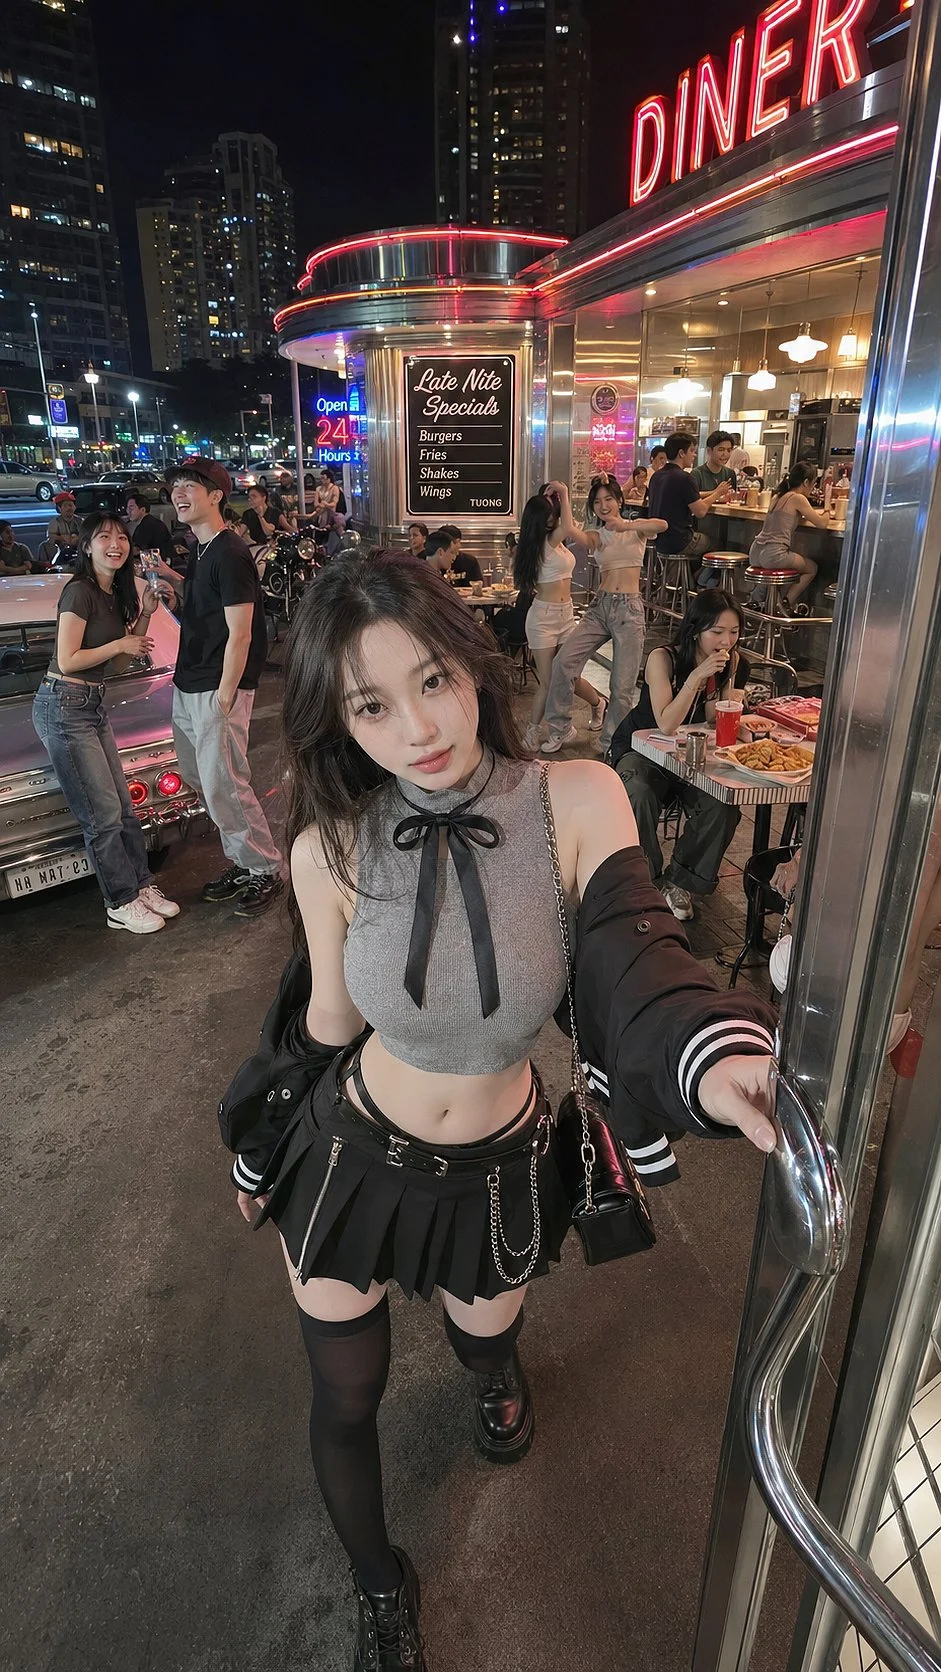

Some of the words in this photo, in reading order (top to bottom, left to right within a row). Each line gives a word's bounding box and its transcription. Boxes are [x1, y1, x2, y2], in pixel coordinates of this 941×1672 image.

[629, 0, 866, 208] DINER
[413, 368, 458, 394] Late
[461, 368, 502, 393] Nite
[316, 397, 348, 416] Open
[422, 395, 500, 423] Specials
[316, 417, 349, 445] 24
[419, 429, 463, 444] Burgers
[319, 448, 351, 462] Hours
[419, 448, 447, 460] Fries
[419, 467, 459, 479] Shakes
[420, 485, 452, 500] Wings
[469, 498, 502, 507] TUONG
